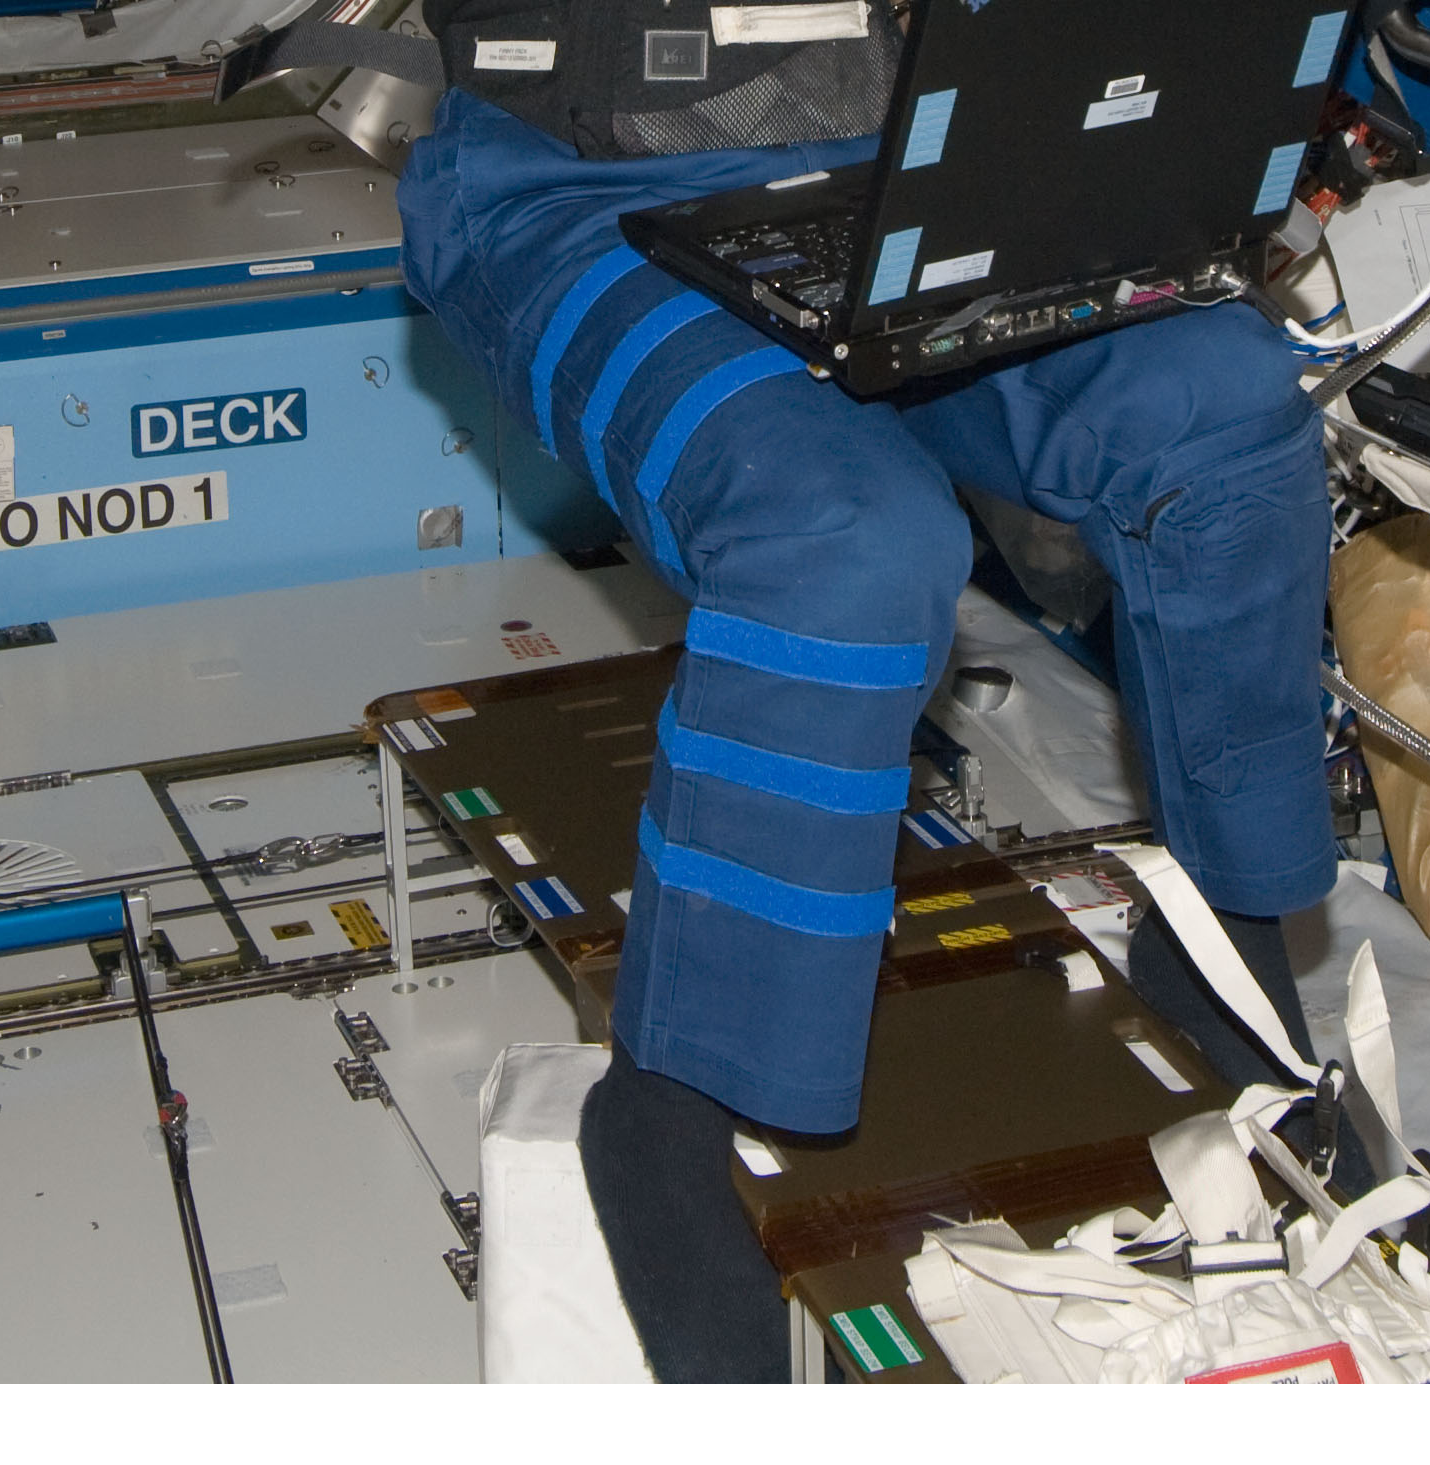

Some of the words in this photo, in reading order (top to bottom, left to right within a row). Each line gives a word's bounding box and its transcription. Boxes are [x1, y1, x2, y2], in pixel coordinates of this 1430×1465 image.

[137, 393, 304, 452] DECK
[55, 482, 178, 541] NOD
[192, 477, 215, 522] 1
